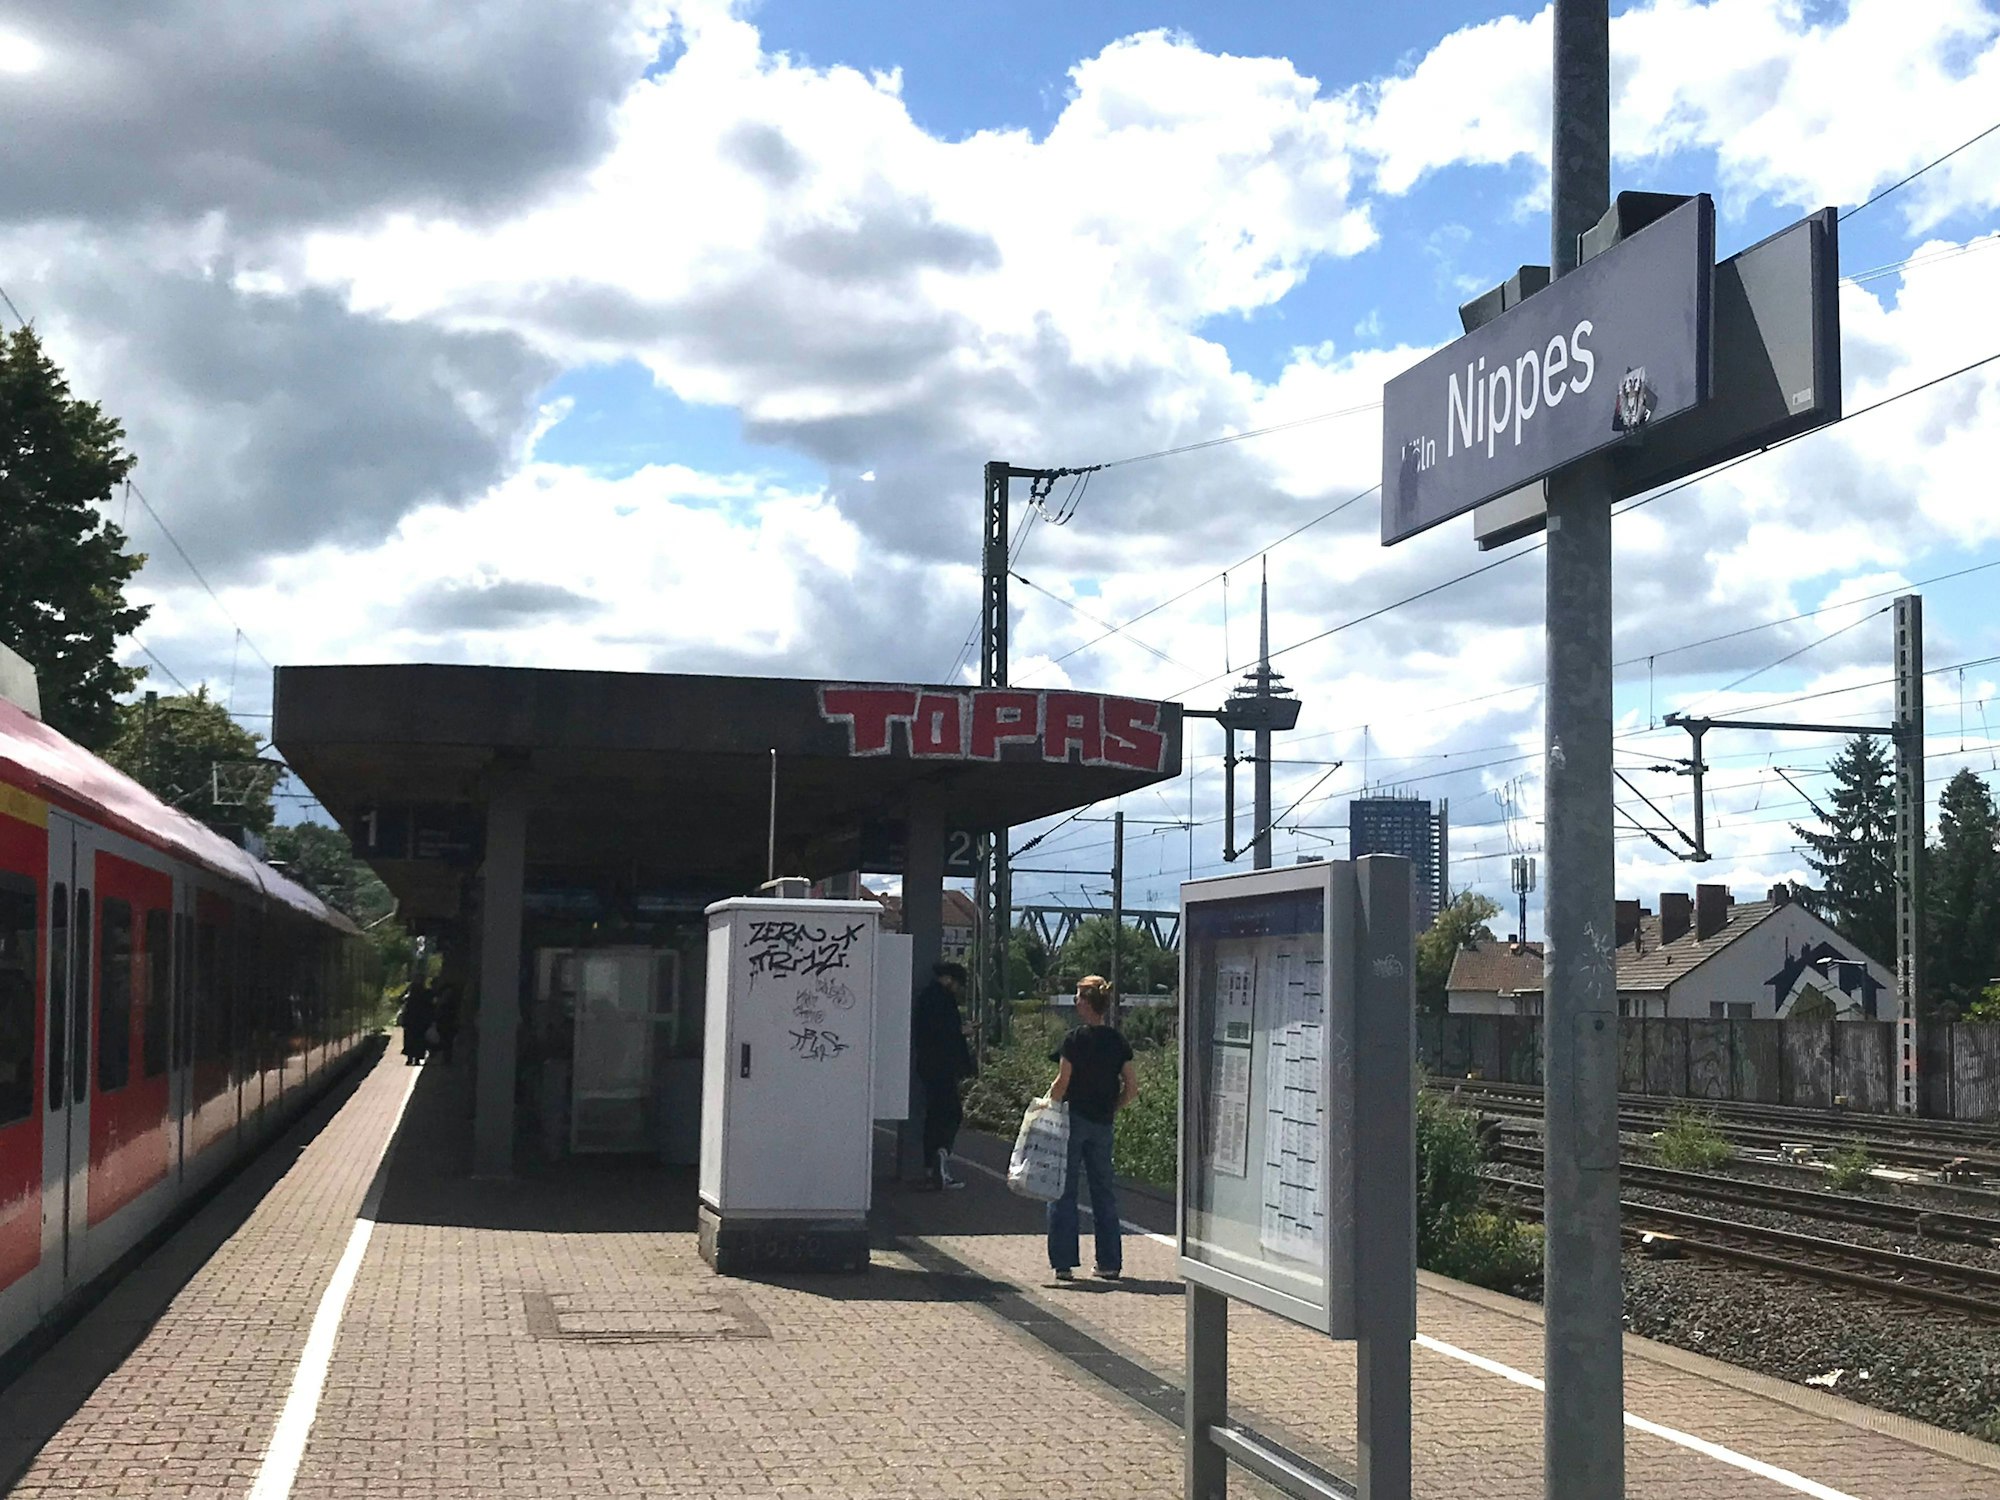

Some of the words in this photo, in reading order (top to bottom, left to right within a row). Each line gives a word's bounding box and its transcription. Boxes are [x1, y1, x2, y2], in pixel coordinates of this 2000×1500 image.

[1446, 319, 1596, 459] Nippes
[816, 683, 1168, 773] TOPAS
[361, 810, 378, 847] 1
[948, 830, 971, 866] 2
